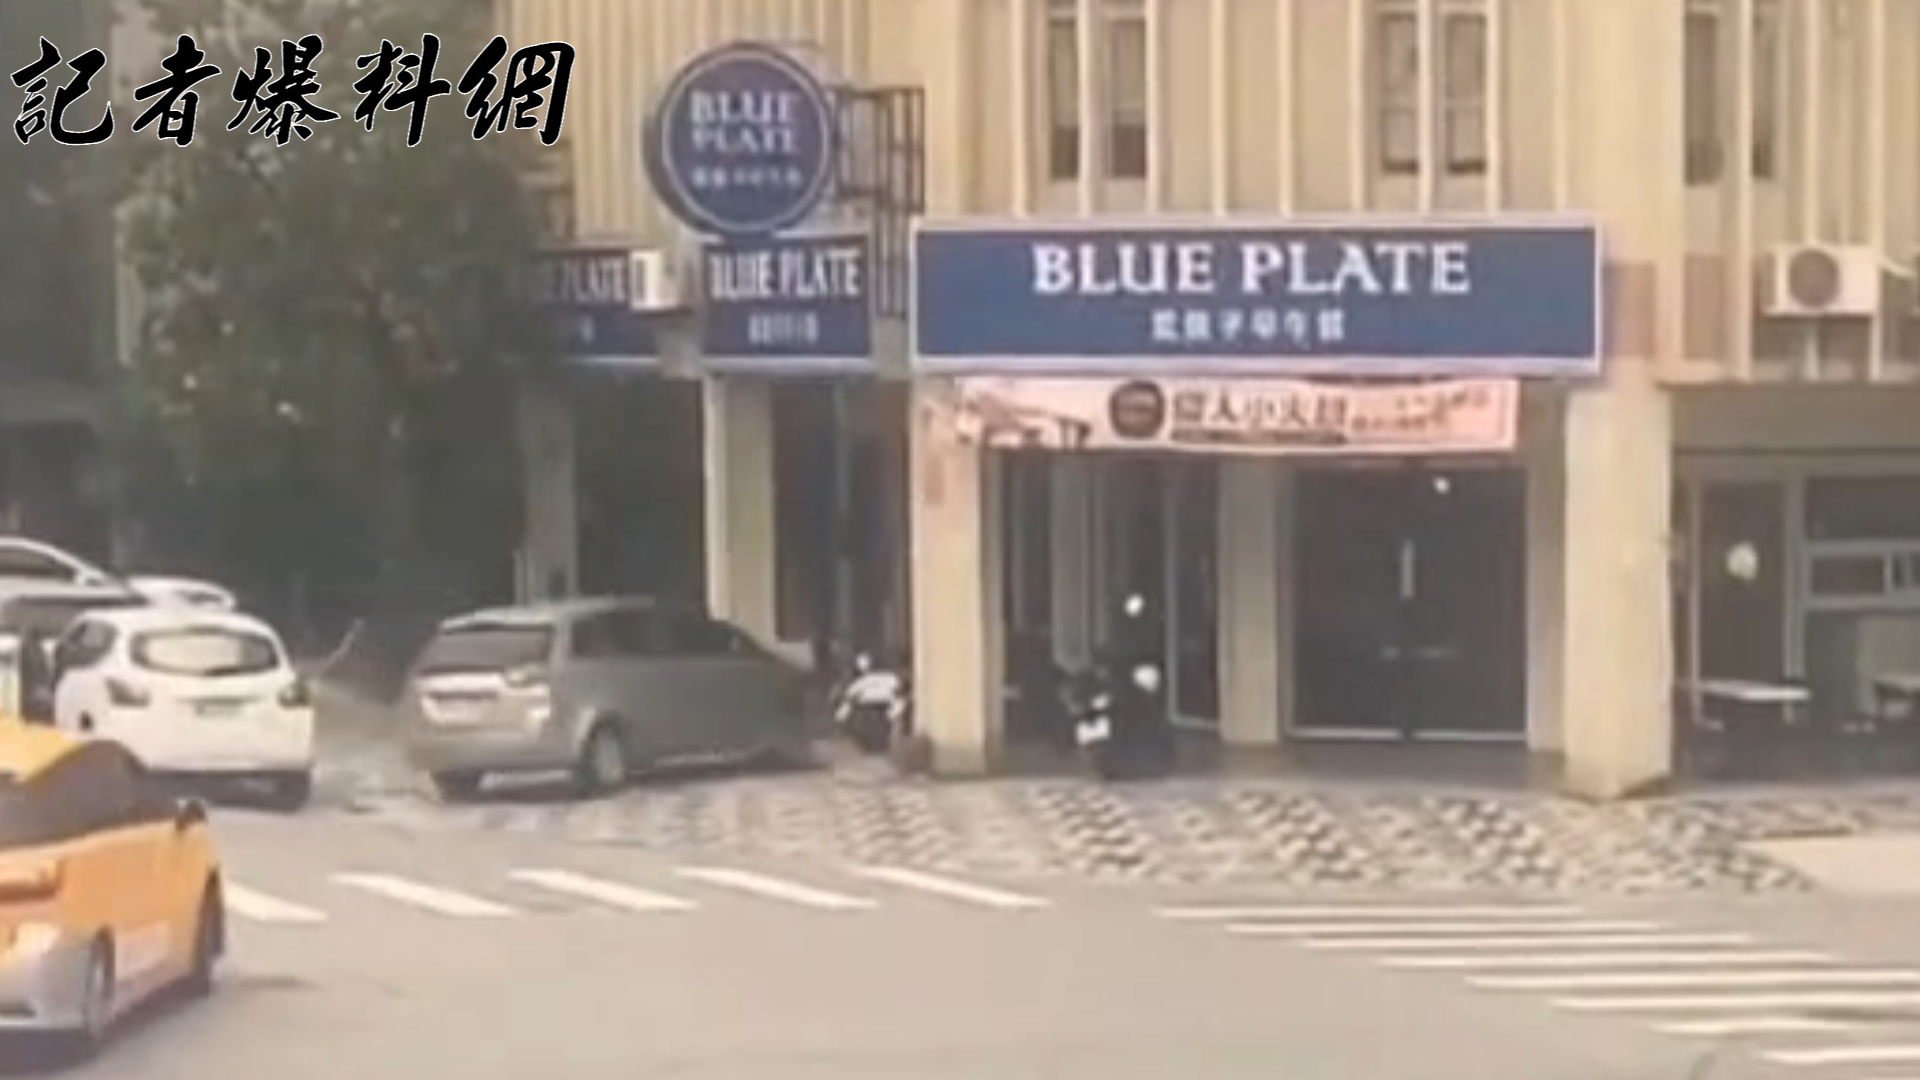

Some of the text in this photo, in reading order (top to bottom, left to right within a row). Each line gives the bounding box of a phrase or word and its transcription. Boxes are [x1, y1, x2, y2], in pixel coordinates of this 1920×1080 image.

[690, 90, 798, 123] BLUE
[691, 128, 798, 154] PLATE
[778, 248, 861, 299] PLATE
[1032, 242, 1471, 294] BLUE PLATE
